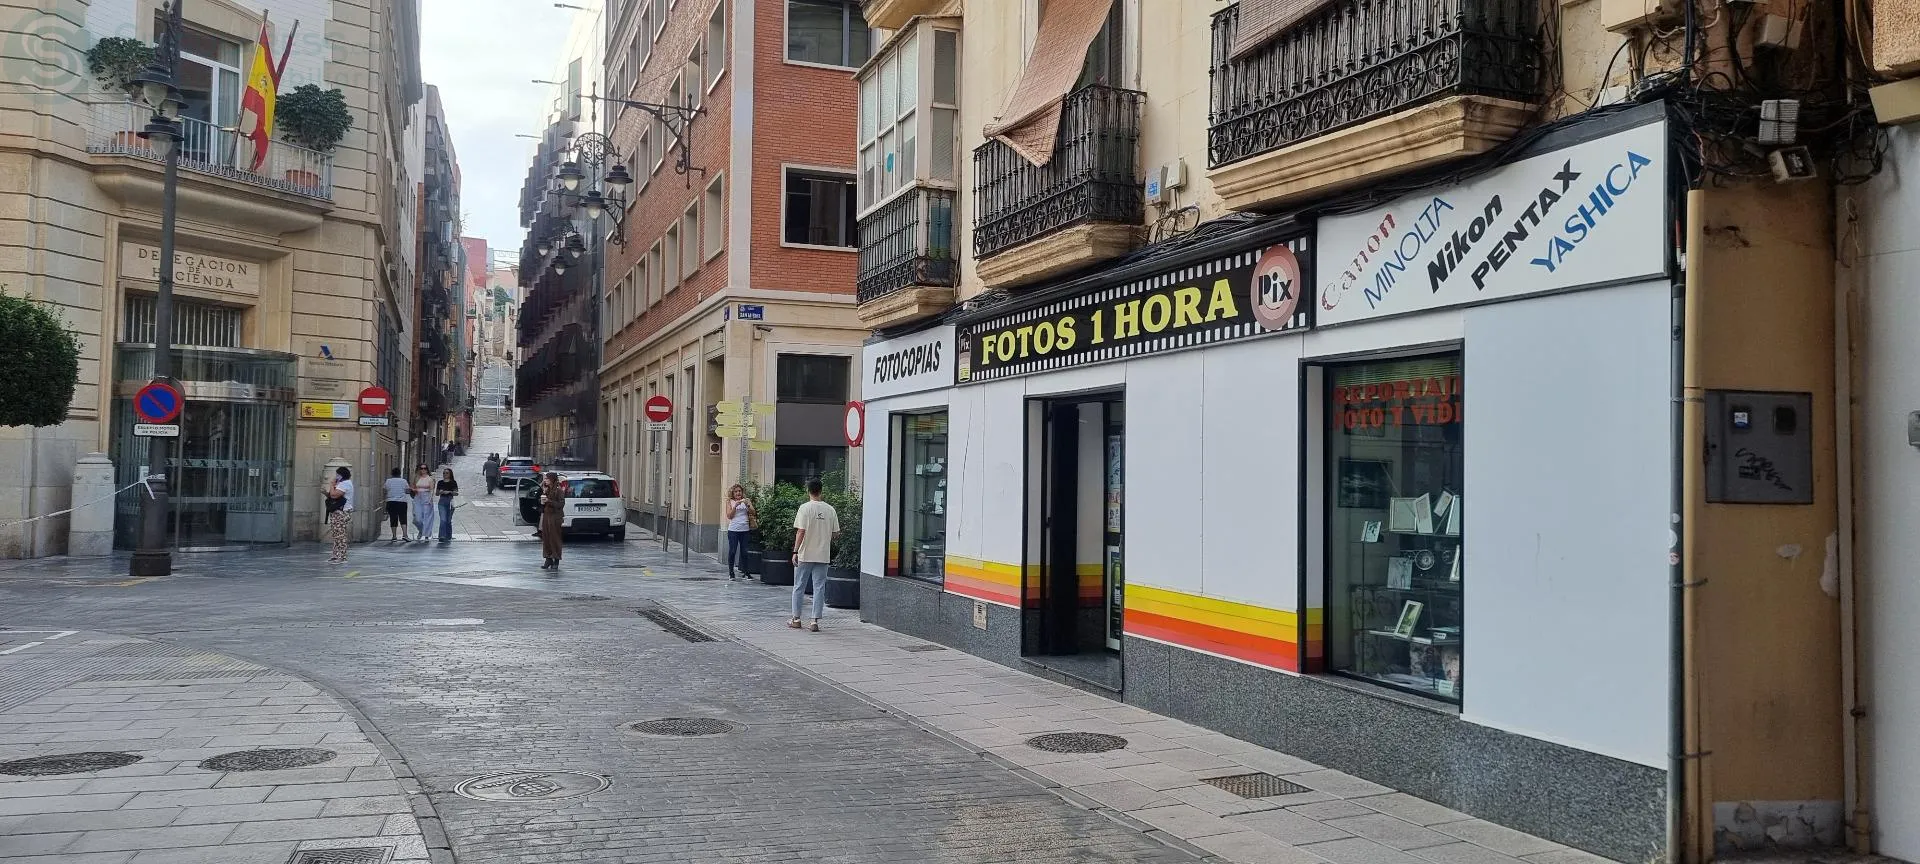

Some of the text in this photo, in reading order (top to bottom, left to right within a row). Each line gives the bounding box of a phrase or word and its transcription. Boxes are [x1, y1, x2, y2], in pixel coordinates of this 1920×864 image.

[1363, 197, 1454, 310] MINOLTA
[1426, 194, 1503, 294] Nikon
[1470, 158, 1582, 291] PENTAX
[1529, 151, 1652, 273] YASHICA
[138, 248, 248, 276] DEEGACION
[152, 267, 234, 289] HCIENDA
[188, 266, 201, 274] DE
[1258, 272, 1293, 307] Pix
[1321, 213, 1396, 310] Canon
[873, 340, 942, 384] FOTOCOPIAS
[982, 278, 1238, 365] FOTOS 1 HORA
